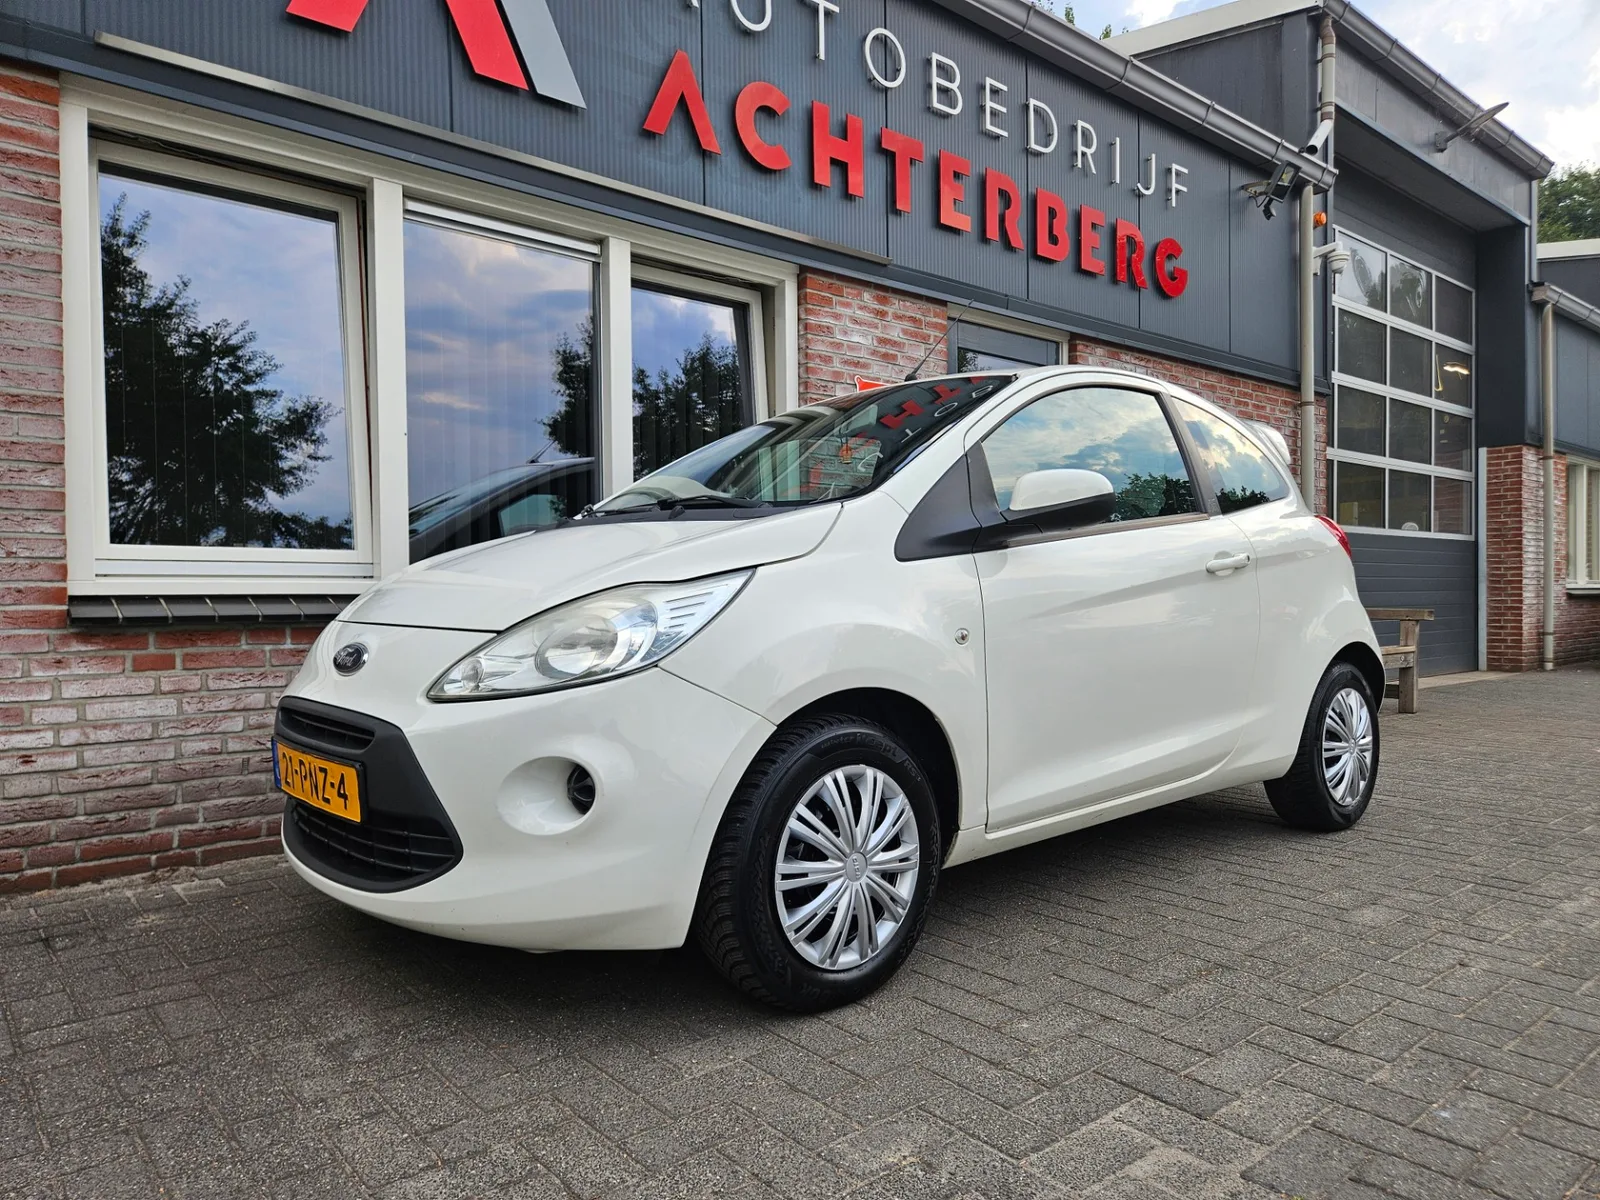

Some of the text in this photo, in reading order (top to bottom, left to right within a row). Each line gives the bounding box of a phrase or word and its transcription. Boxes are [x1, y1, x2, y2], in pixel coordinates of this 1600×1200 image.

[691, 0, 1189, 207] UTOBEDRIJF
[643, 49, 1189, 298] ACHTERBERG
[336, 648, 359, 667] Ford
[282, 752, 350, 811] 21-PNZ-4
